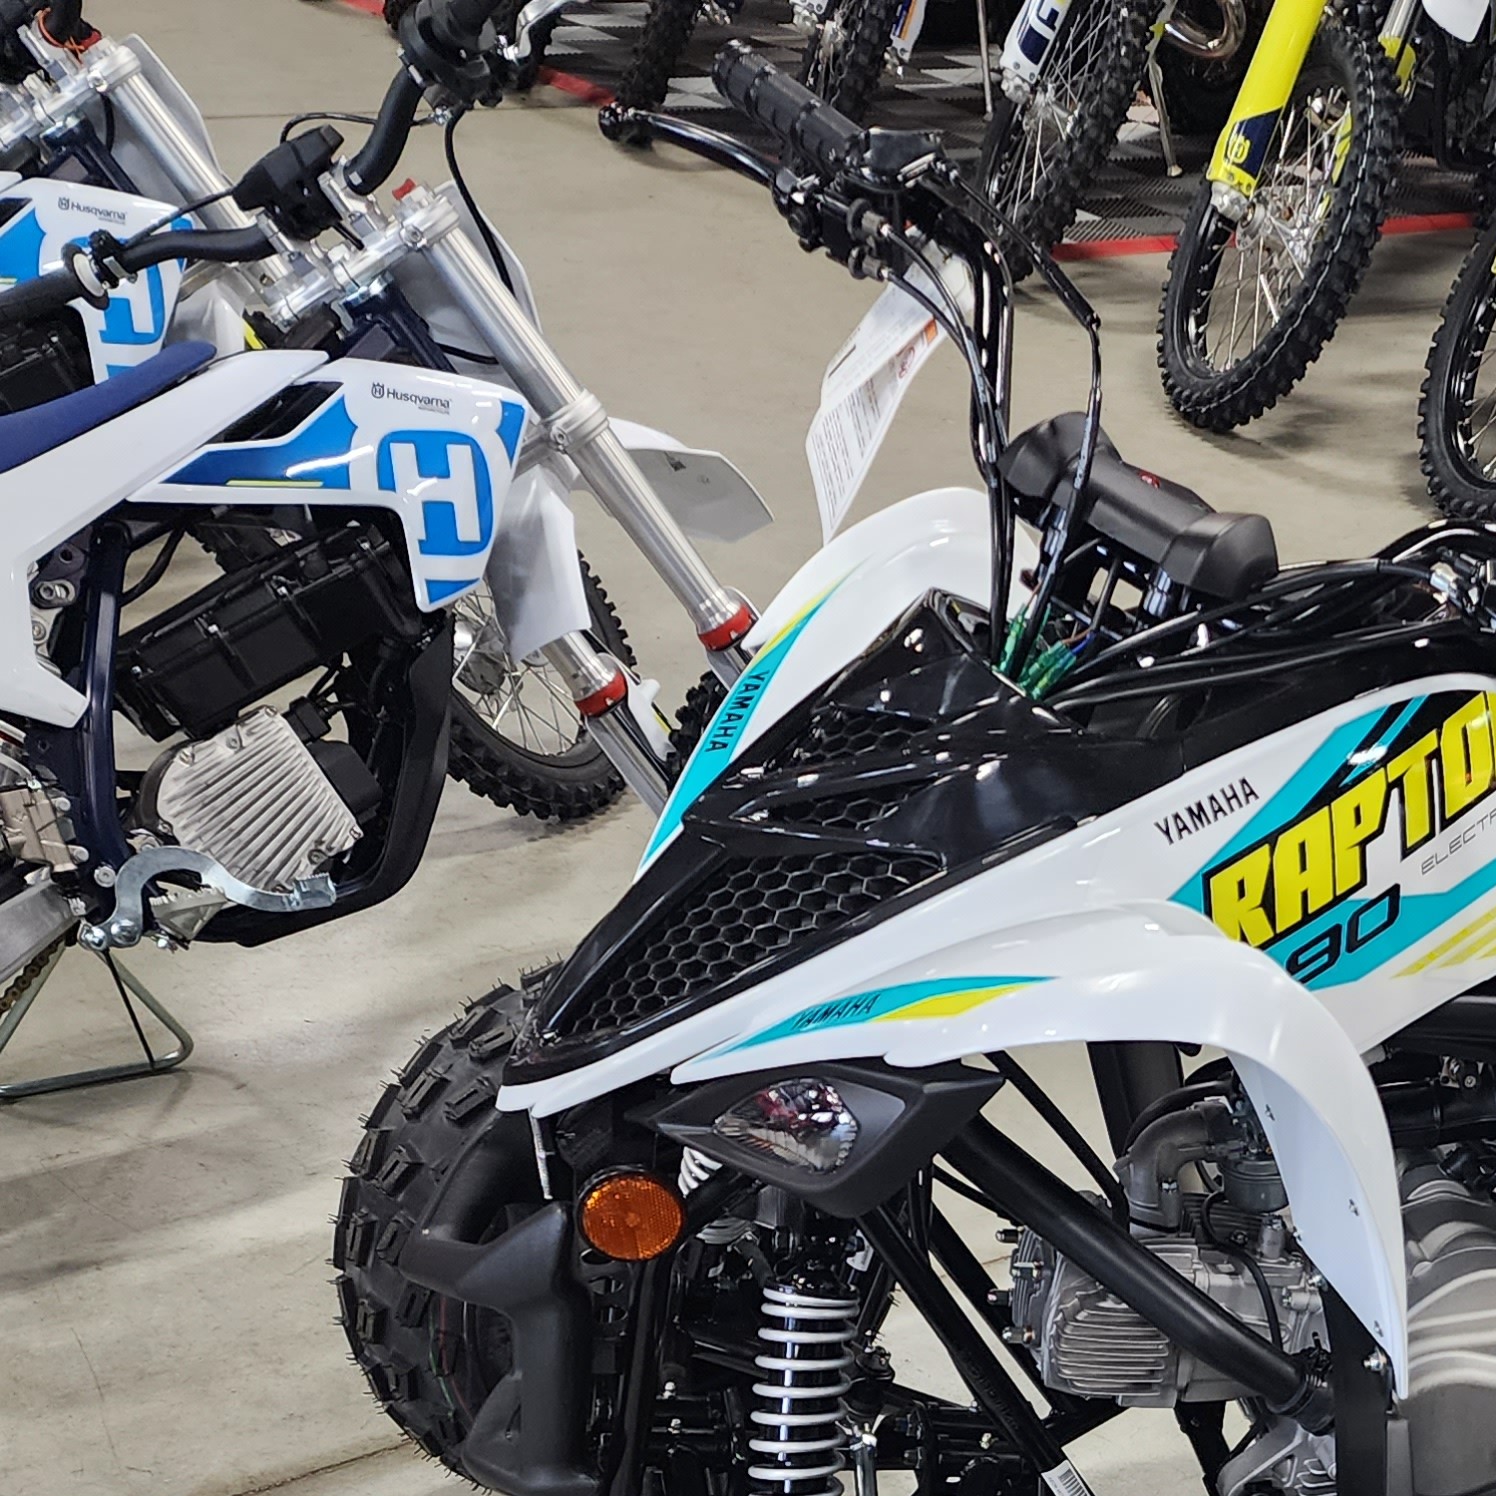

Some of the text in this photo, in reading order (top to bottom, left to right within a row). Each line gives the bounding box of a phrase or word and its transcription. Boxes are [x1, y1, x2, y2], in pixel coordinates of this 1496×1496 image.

[71, 201, 126, 220] Husqvarna
[386, 387, 450, 409] Husqvarna
[706, 669, 770, 753] YAMAHA
[1153, 776, 1260, 846] YAMAHA
[1285, 883, 1401, 985] 90
[790, 991, 881, 1030] YAMAHA
